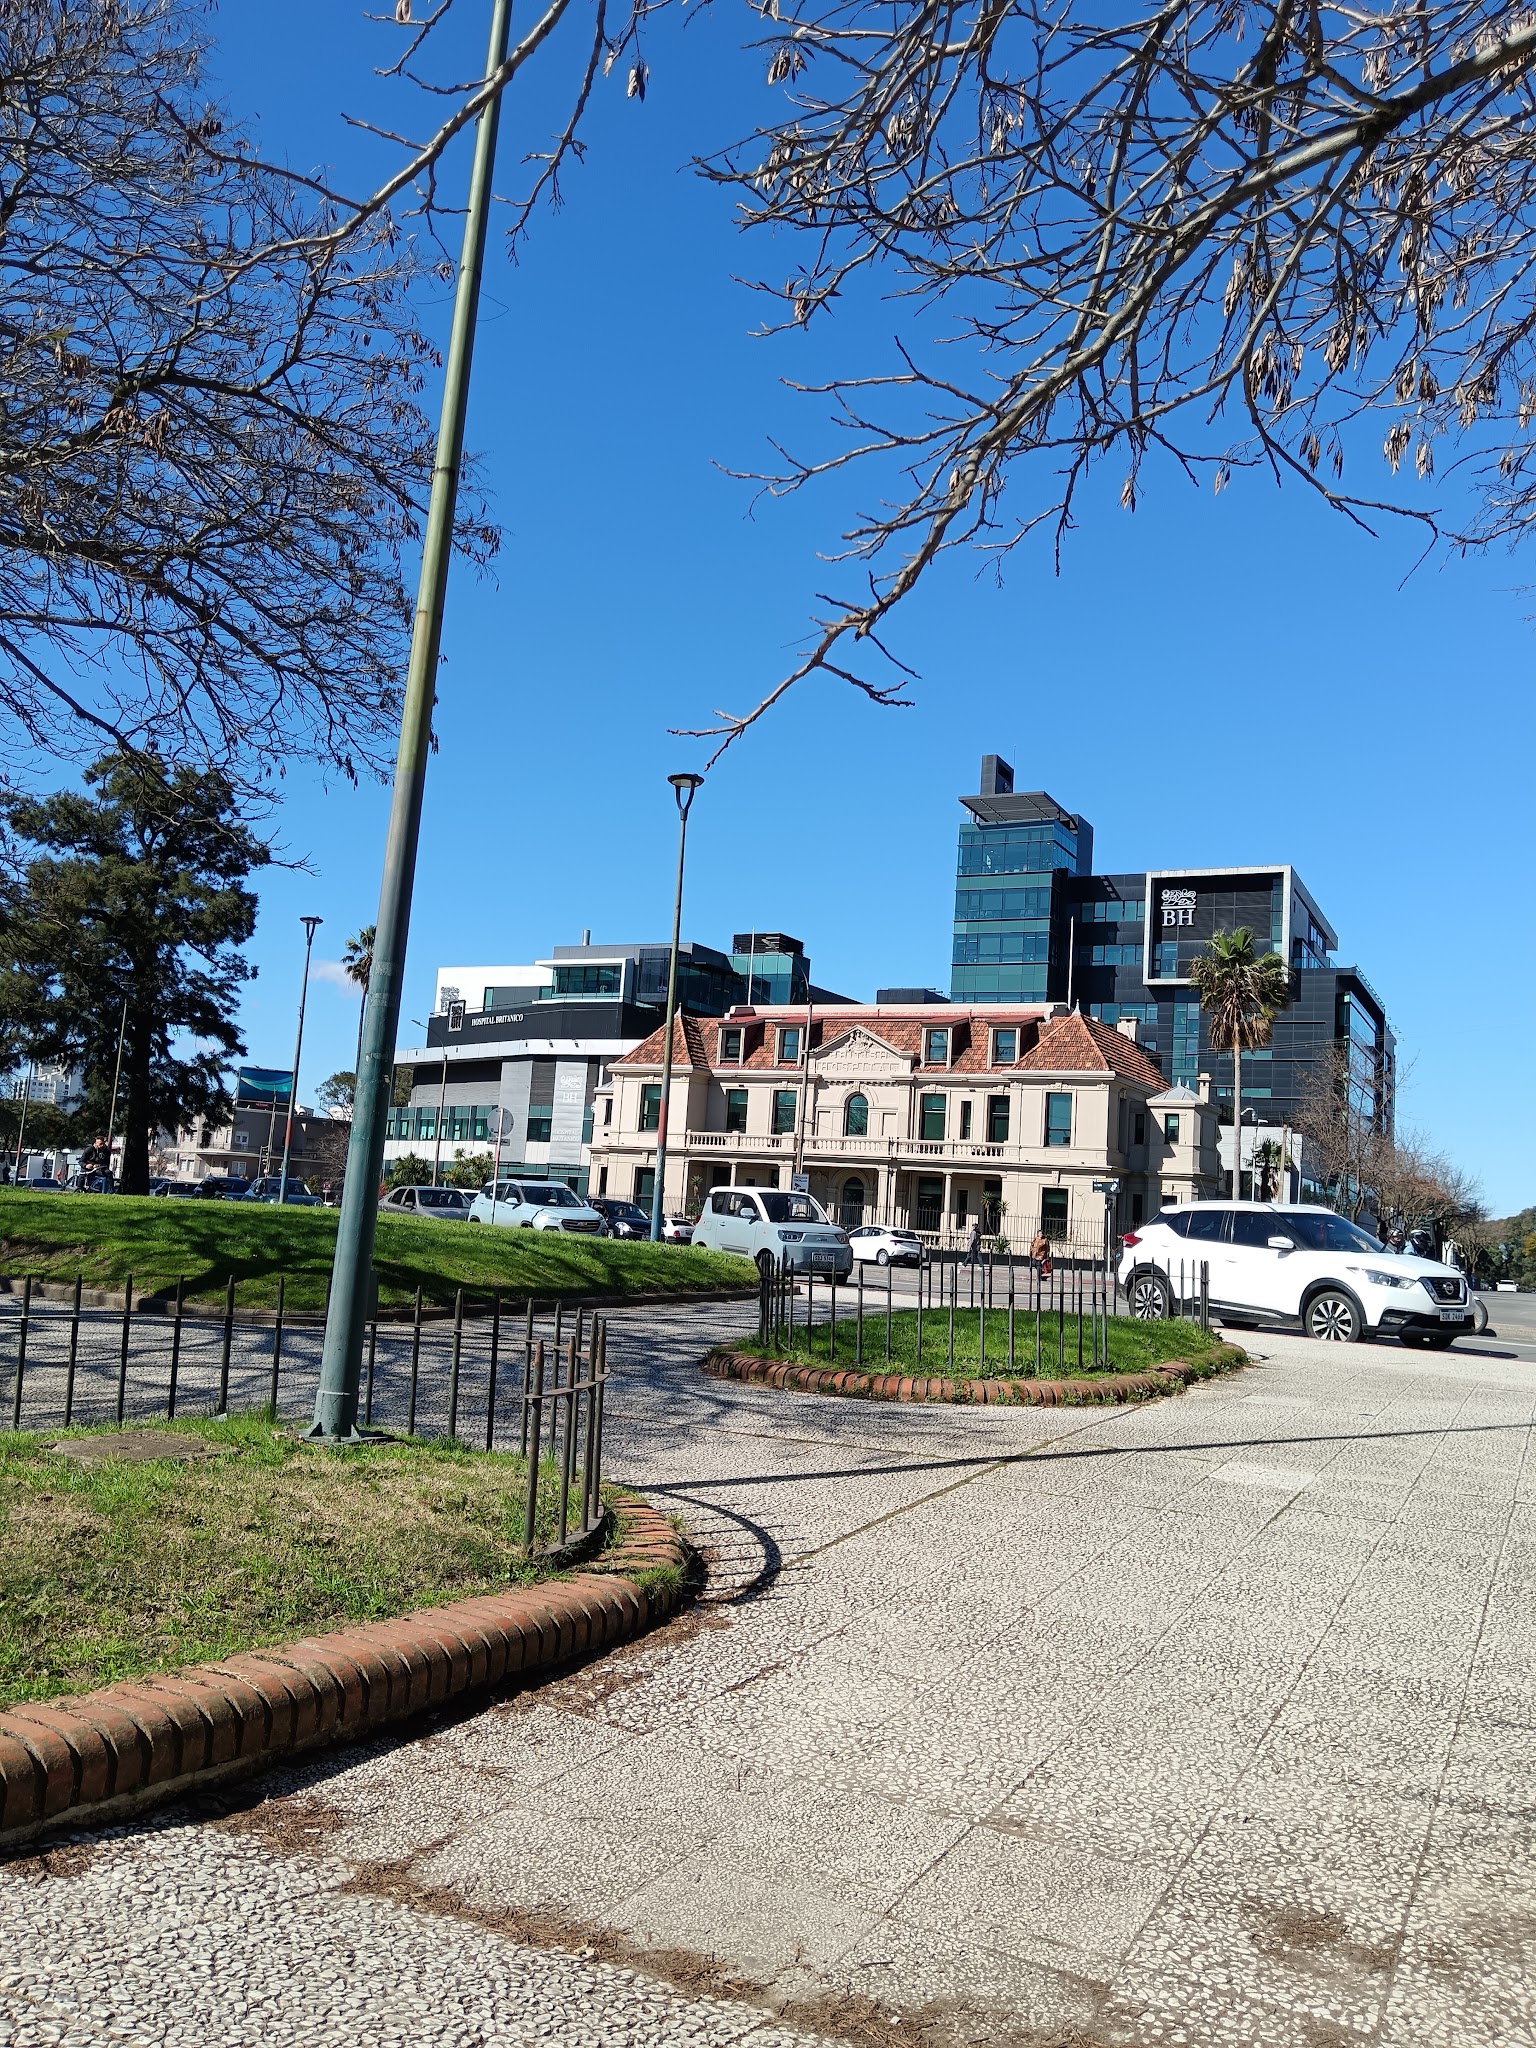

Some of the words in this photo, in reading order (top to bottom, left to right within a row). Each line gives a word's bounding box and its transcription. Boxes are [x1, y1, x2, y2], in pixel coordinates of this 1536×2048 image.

[1162, 909, 1195, 926] BH
[471, 1016, 495, 1027] HOSPITAL
[816, 1061, 900, 1072] HOSPITAL
[562, 1092, 578, 1104] BH
